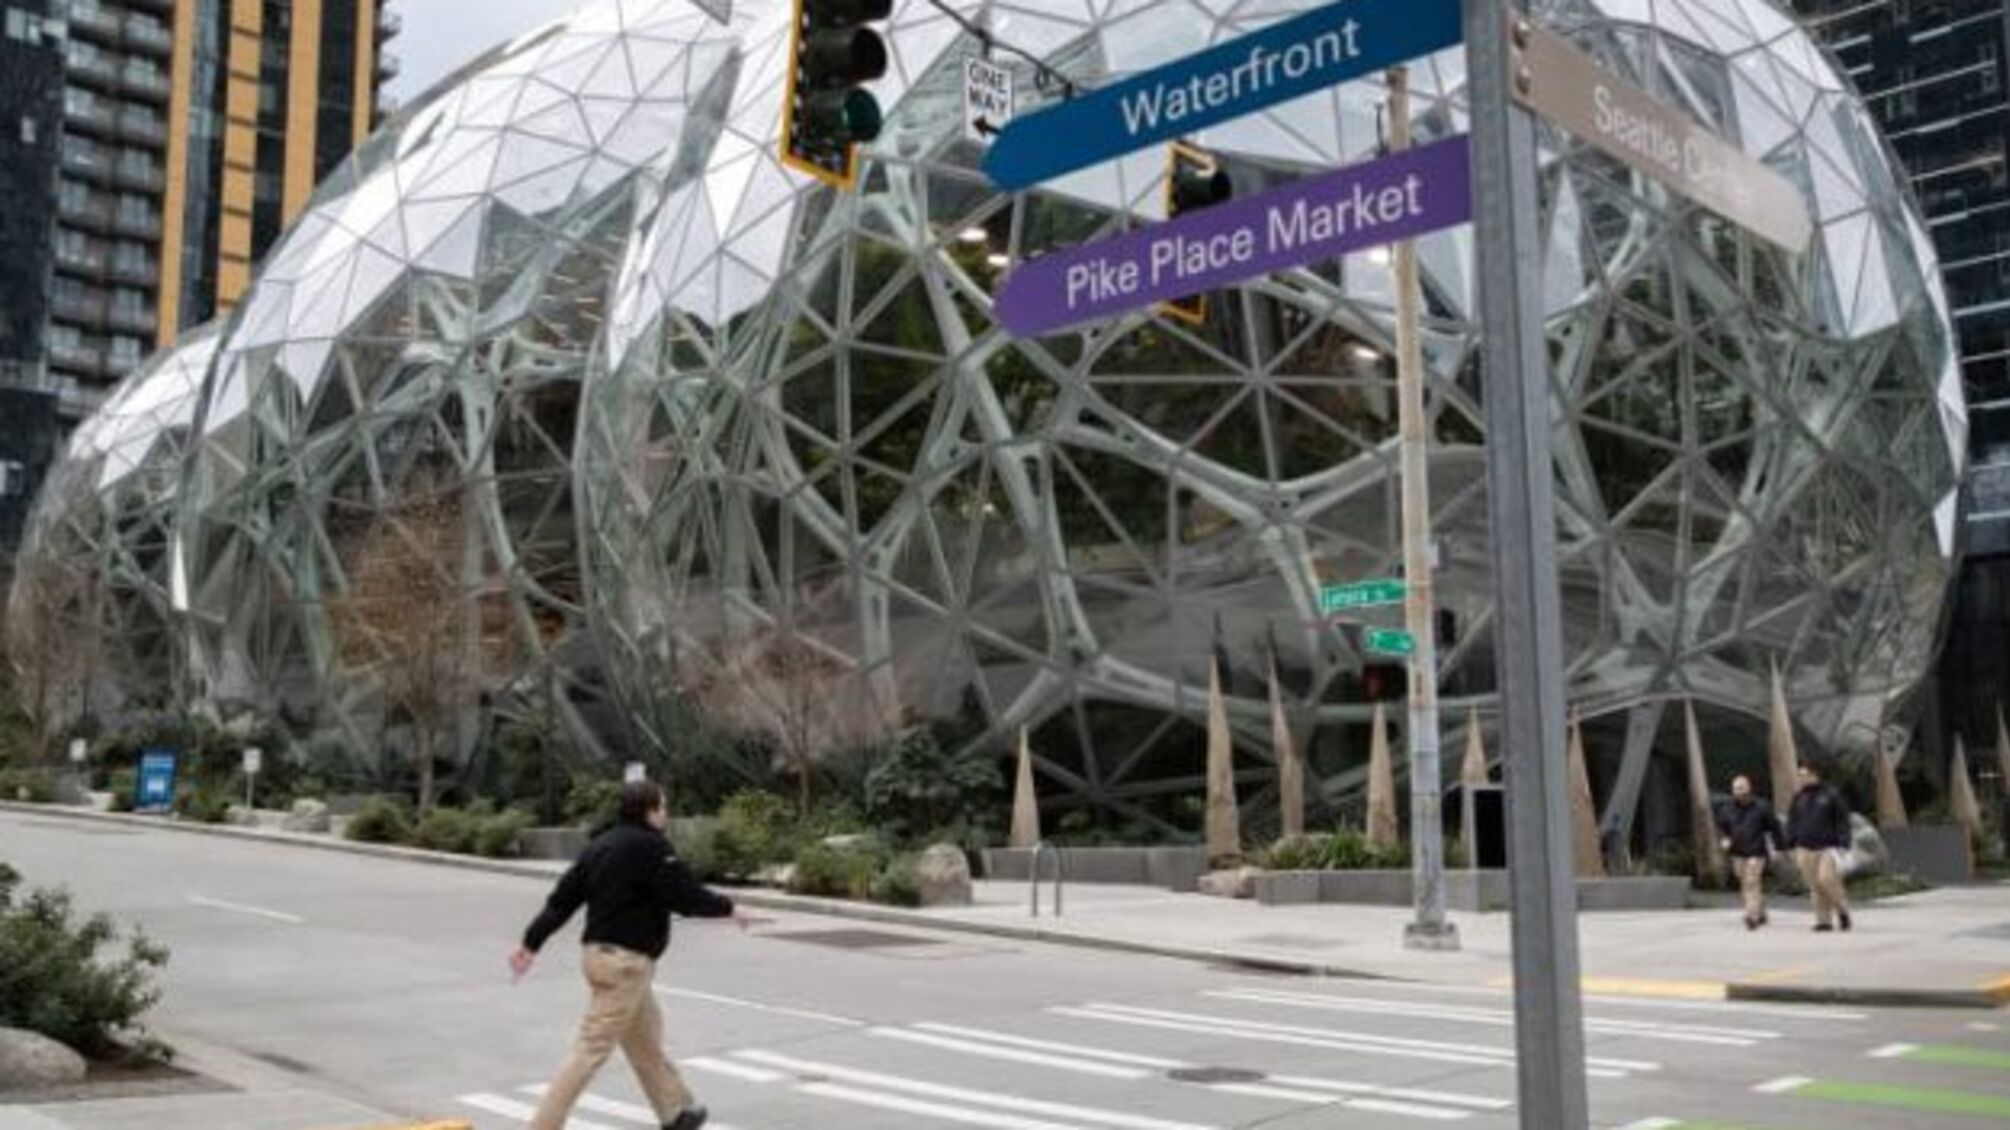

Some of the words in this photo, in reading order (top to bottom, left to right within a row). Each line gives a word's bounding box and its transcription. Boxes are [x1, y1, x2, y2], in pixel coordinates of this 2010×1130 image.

[968, 62, 1007, 93] ONE
[968, 86, 1007, 116] WAY
[1121, 18, 1362, 136] Waterfront
[1593, 84, 1680, 171] Seattle
[1066, 261, 1140, 308] Pike
[1151, 230, 1256, 284] Place
[1267, 173, 1423, 253] Market
